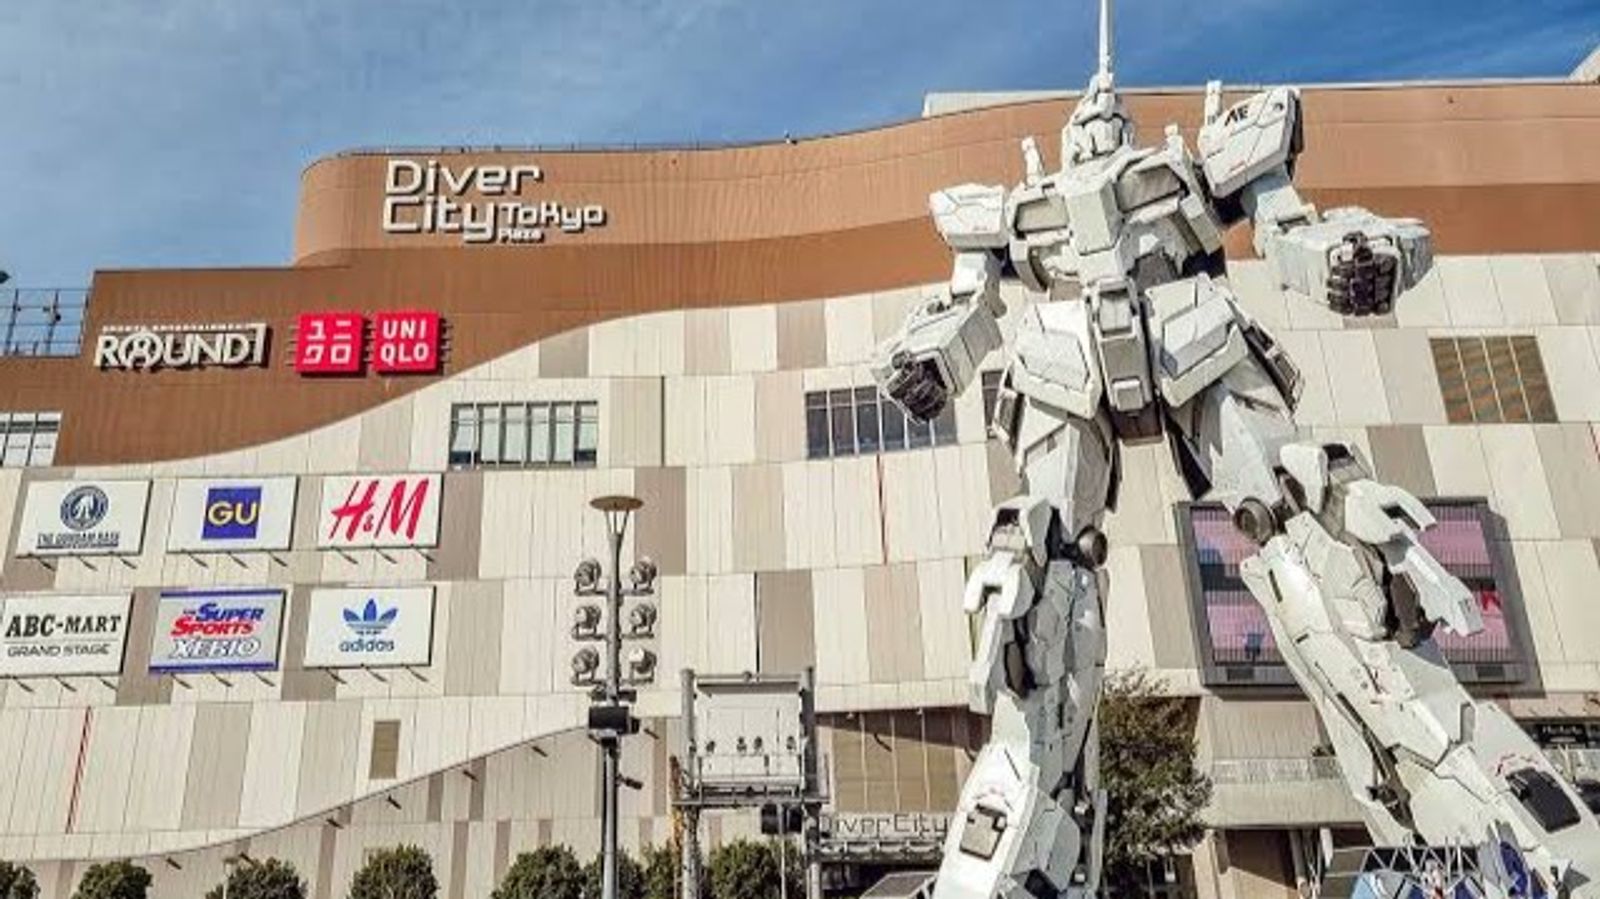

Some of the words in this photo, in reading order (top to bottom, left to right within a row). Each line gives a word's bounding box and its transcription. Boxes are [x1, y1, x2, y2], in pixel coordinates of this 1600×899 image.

[385, 159, 541, 195] Diver
[383, 195, 495, 242] City
[501, 201, 604, 230] Tokyo
[383, 318, 427, 340] UNI
[380, 342, 430, 366] QLO
[207, 501, 258, 526] GU
[328, 477, 430, 542] H&M
[196, 602, 265, 621] SUPER
[5, 613, 122, 638] ABC-MART
[170, 616, 254, 637] SPORTS
[7, 645, 61, 657] GRAND
[63, 643, 111, 656] STAGE
[339, 638, 395, 653] adidas
